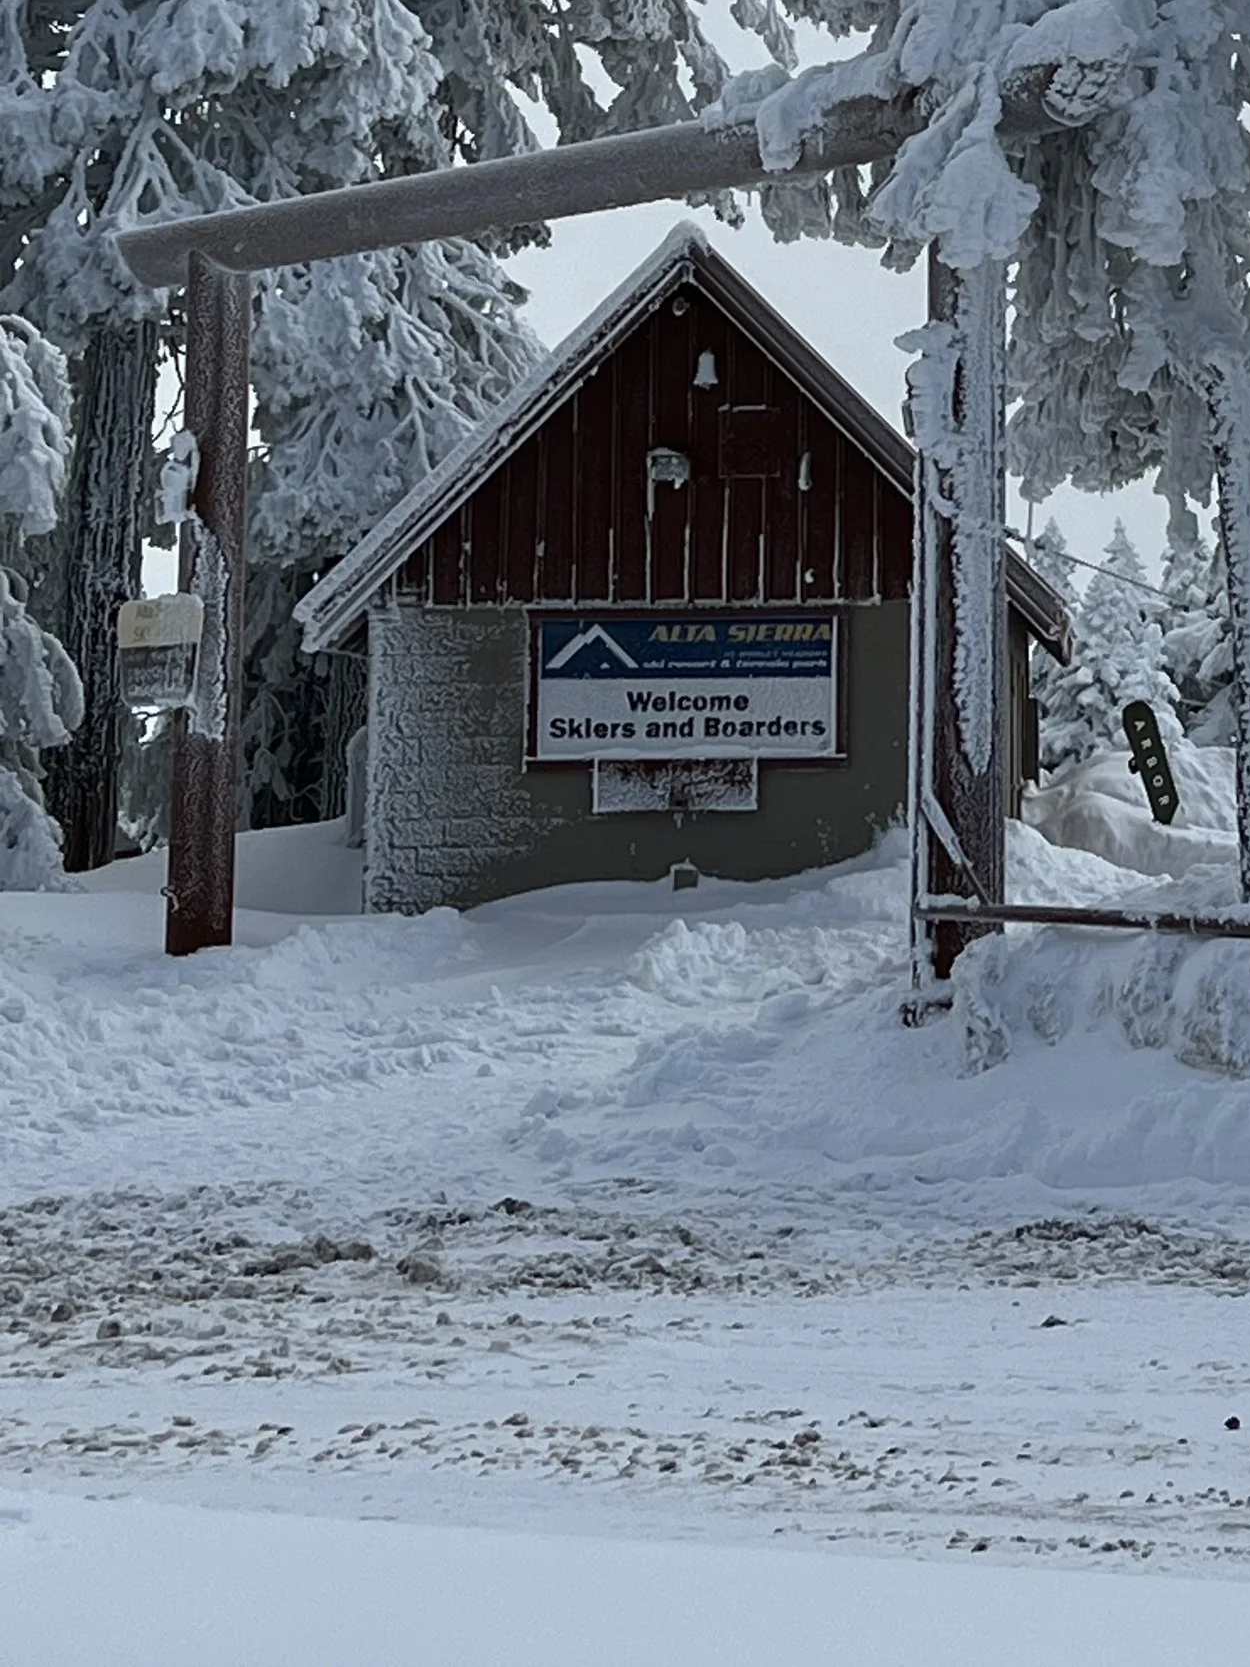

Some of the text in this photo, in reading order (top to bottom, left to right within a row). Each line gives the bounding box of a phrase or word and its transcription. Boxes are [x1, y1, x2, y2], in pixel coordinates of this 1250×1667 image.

[649, 624, 832, 642] ALTA SIERRA
[627, 691, 749, 712] Welcome
[549, 716, 826, 739] Skiers and Boarders
[1133, 720, 1170, 806] ARBOR
